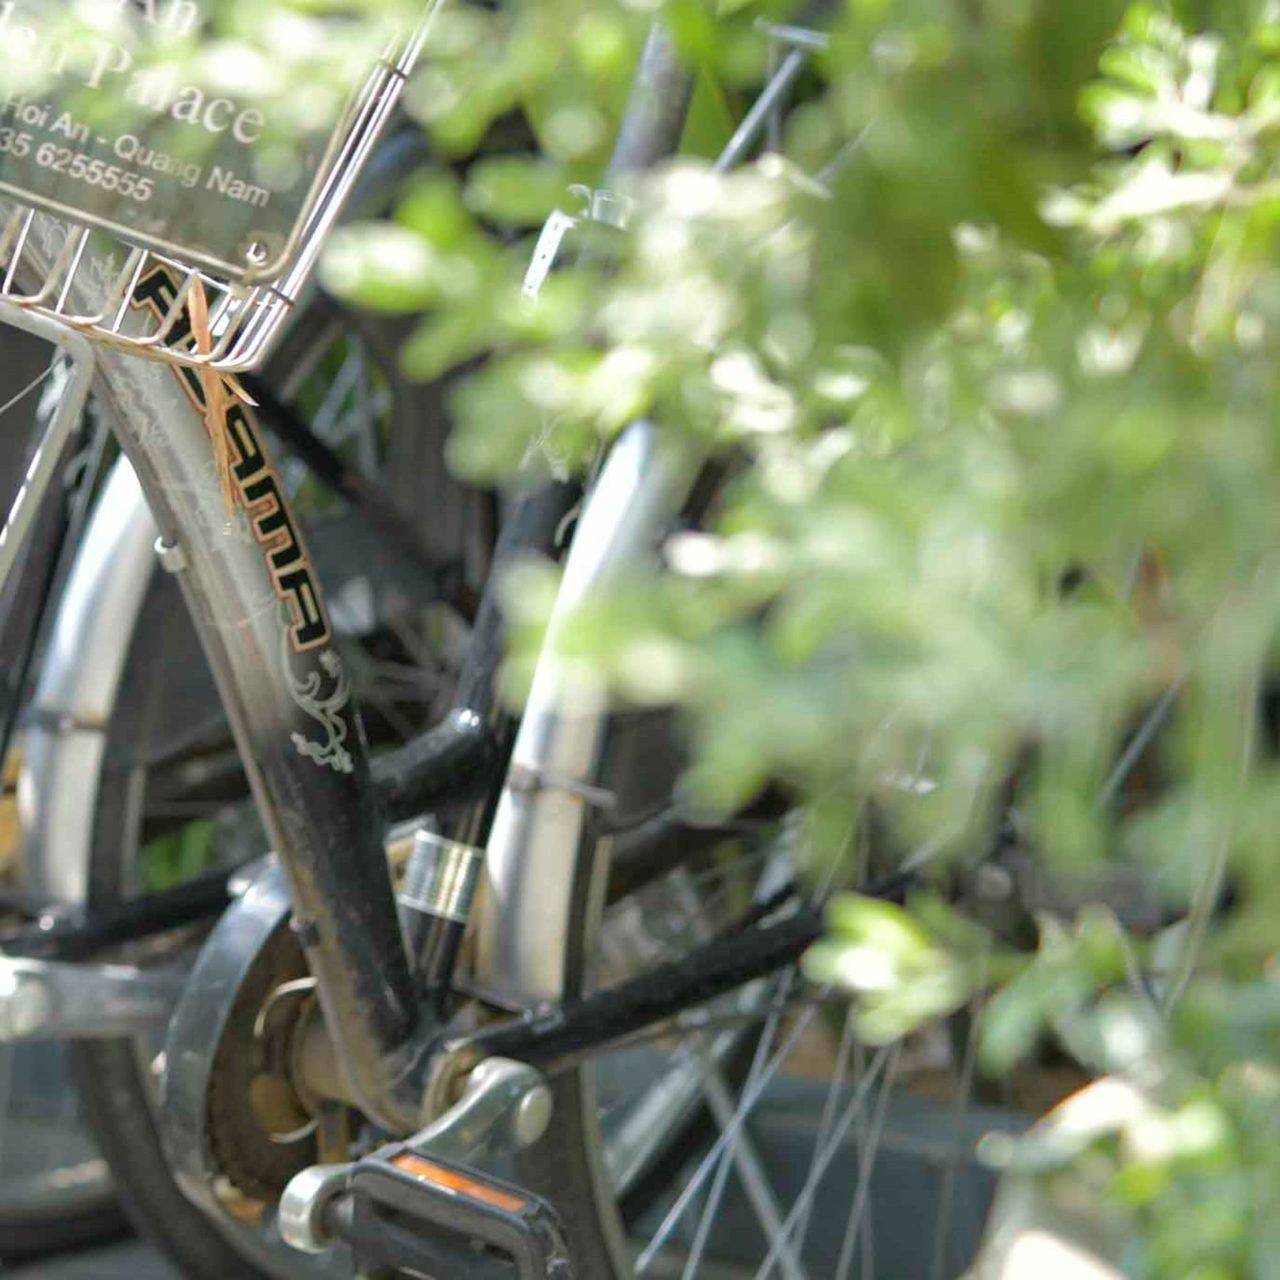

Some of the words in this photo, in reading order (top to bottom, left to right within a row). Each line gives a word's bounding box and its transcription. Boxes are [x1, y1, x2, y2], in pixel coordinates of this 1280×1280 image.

[1, 90, 47, 127] Hoi
[49, 112, 89, 145] An
[114, 134, 199, 188] Quang
[207, 166, 271, 207] Nam
[36, 142, 155, 203] 6255555
